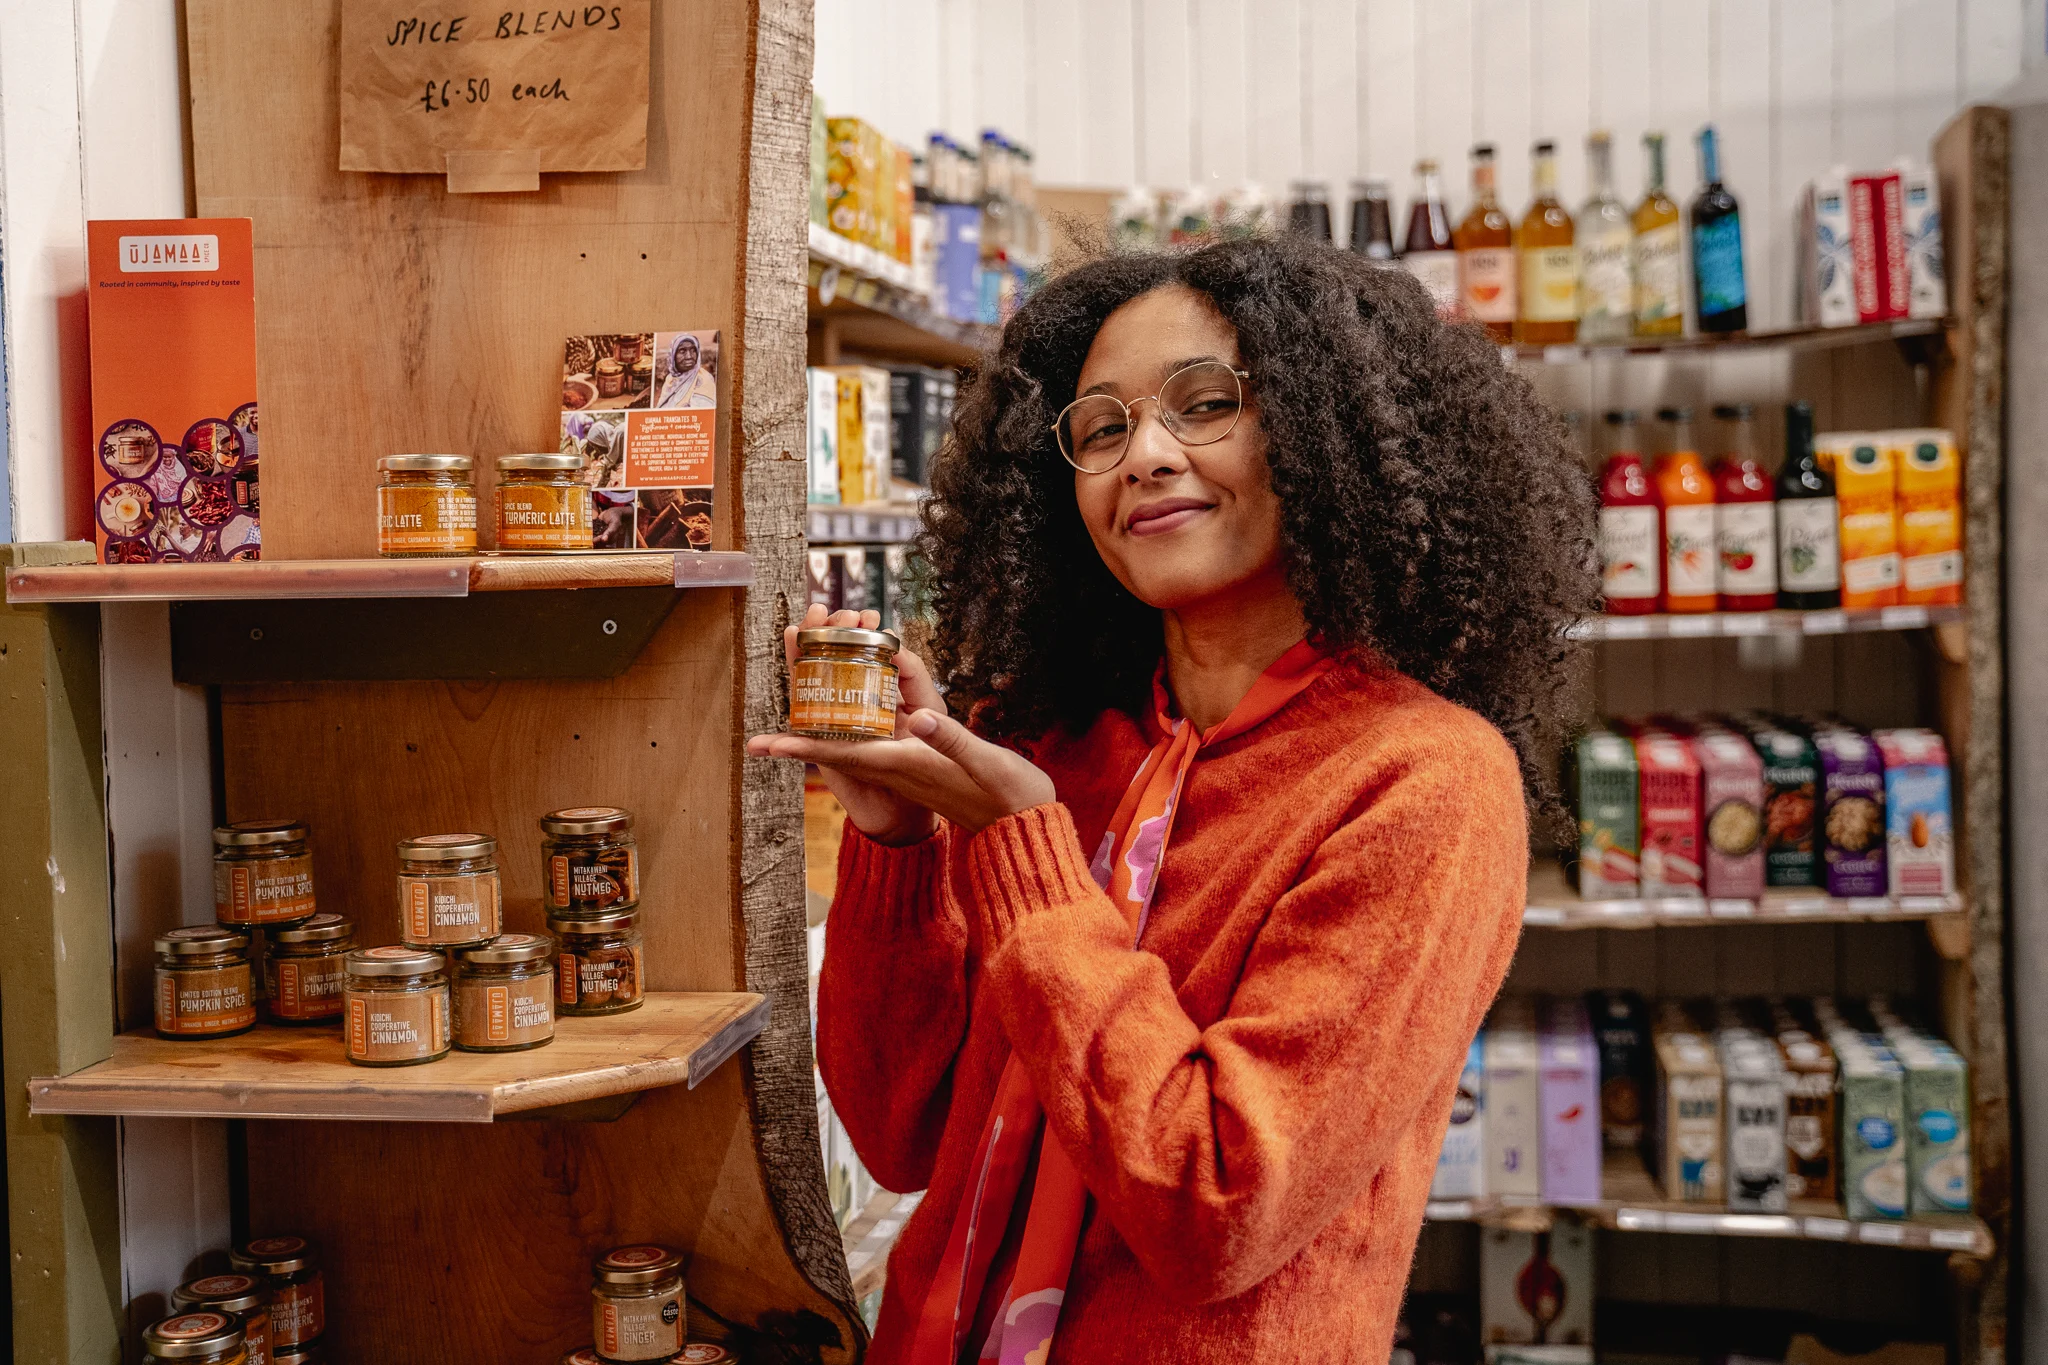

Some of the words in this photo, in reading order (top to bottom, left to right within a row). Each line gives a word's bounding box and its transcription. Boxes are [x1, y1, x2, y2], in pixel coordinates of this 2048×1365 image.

[387, 15, 469, 46] SPICE
[495, 6, 622, 40] BLENDS
[512, 78, 570, 101] each
[136, 280, 179, 288] community,
[180, 279, 209, 288] inspired
[210, 279, 220, 288] by
[517, 502, 532, 510] BLEND
[395, 514, 422, 528] LATTE
[549, 512, 575, 525] LATTE
[838, 689, 868, 704] LATTE
[254, 879, 275, 887] LIMITED
[276, 876, 294, 885] EDITION
[574, 874, 596, 882] VILLAGE
[255, 885, 294, 900] PUMPKIN
[297, 881, 312, 895] SPICE
[574, 882, 611, 896] NUTMEG
[434, 903, 473, 913] COOPERATIVE
[435, 912, 480, 926] CINNAMON
[304, 975, 323, 983] LIMITED
[581, 971, 604, 980] VILLAGE
[202, 989, 222, 998] EDITION
[224, 986, 238, 996] BLEND
[304, 981, 342, 996] PUMPKIN
[582, 979, 618, 993] NUTMEG
[180, 998, 220, 1012] PUMPKIN
[224, 993, 246, 1009] SPICE
[514, 1002, 546, 1015] COOPERATIVE
[514, 1010, 550, 1028] CINNAMON
[370, 1021, 410, 1031] COOPERATIVE
[371, 1030, 418, 1044] CINNAMON
[272, 1312, 313, 1333] TURMERIC
[623, 1323, 646, 1332] VILLAGE
[624, 1331, 656, 1344] GINGER
